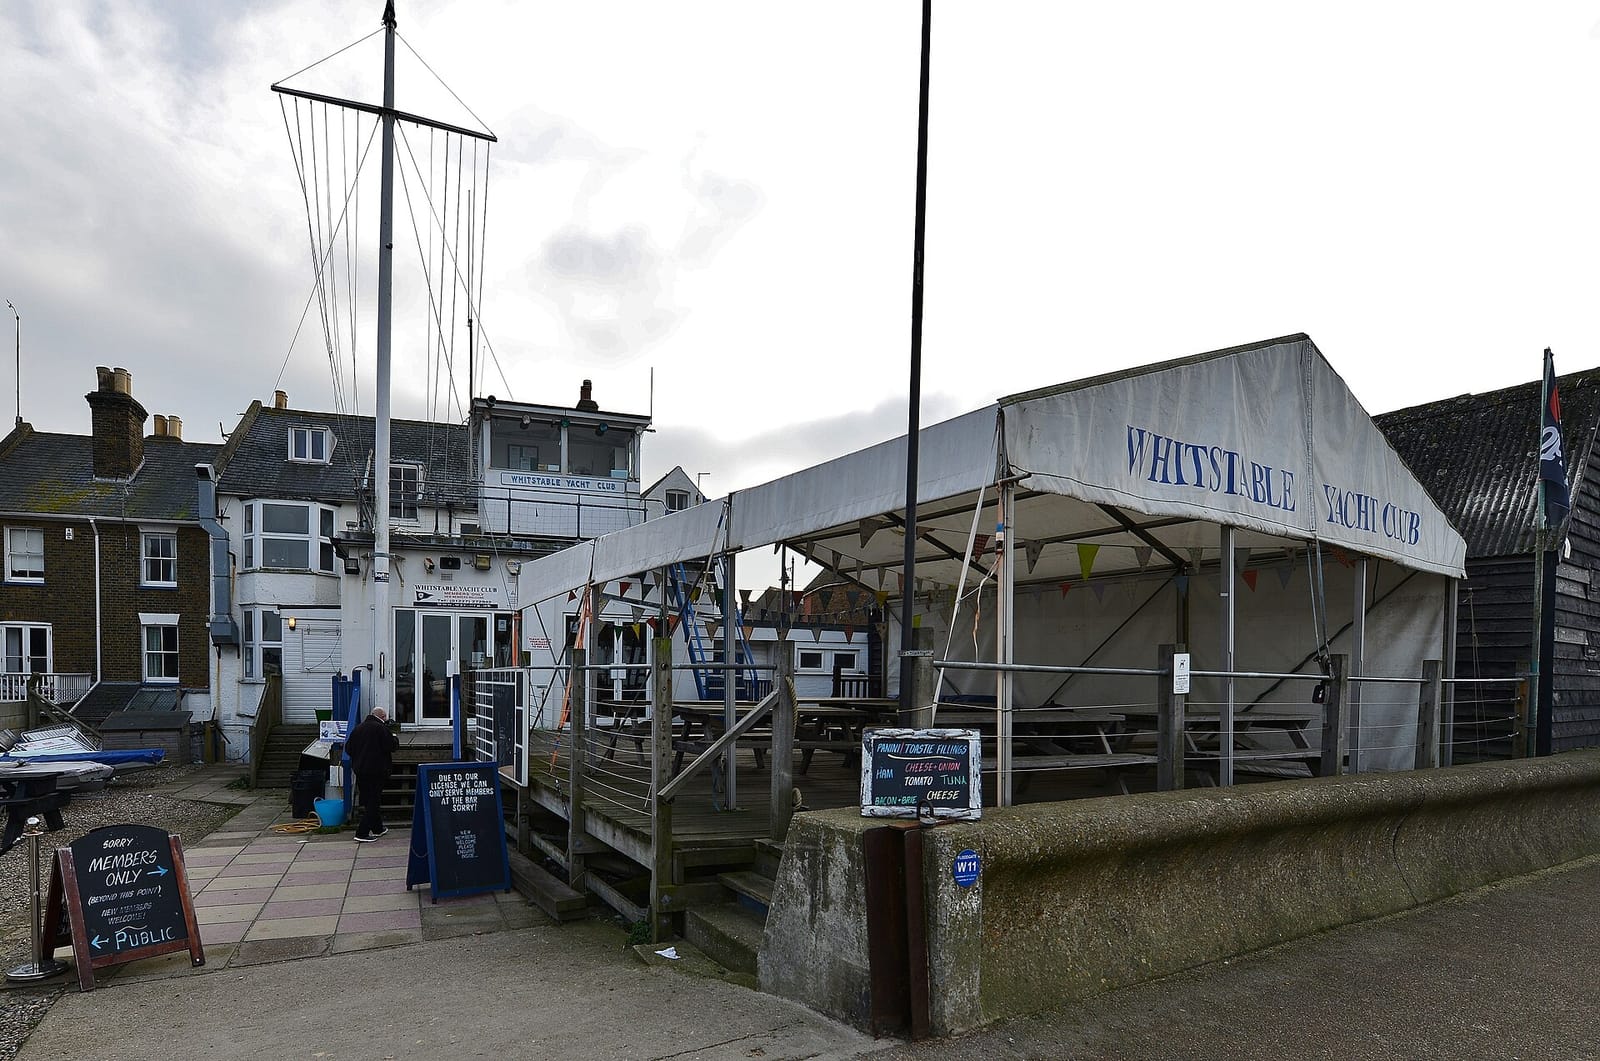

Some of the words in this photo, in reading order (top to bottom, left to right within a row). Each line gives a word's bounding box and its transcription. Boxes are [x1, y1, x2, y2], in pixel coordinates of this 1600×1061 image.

[511, 475, 561, 487] WHITSTABLE
[566, 479, 591, 489] YACHT
[596, 482, 616, 491] CLUB
[1127, 425, 1296, 512] WHITSTABLE
[1323, 484, 1378, 533] YACHT
[1382, 502, 1420, 546] CLUB
[414, 584, 457, 592] WHITSTABLE
[459, 585, 481, 593] YACHT
[936, 744, 968, 755] FILLINGS
[438, 774, 451, 782] DUE
[453, 773, 462, 781] TO
[465, 772, 479, 781] OUR
[876, 768, 894, 780] HAM
[430, 781, 458, 790] LICENSE
[460, 780, 470, 789] WE
[473, 779, 488, 788] CAN
[904, 776, 934, 787] TOMATO
[940, 774, 968, 786] TUNA
[429, 789, 444, 798] ONLY
[444, 788, 464, 797] SERVE
[465, 787, 494, 796] MEMBERS
[926, 790, 961, 801] CHEESE
[440, 796, 450, 805] AT
[451, 796, 463, 805] THE
[465, 796, 478, 805] BAR
[452, 803, 477, 812] SORRY!
[102, 838, 134, 849] SORRY
[88, 849, 158, 873] MEMBERS
[957, 861, 977, 873] W11
[105, 868, 142, 887] ONLY
[119, 890, 135, 900] THIS
[101, 908, 119, 917] NEW
[119, 902, 153, 913] MEMBERS
